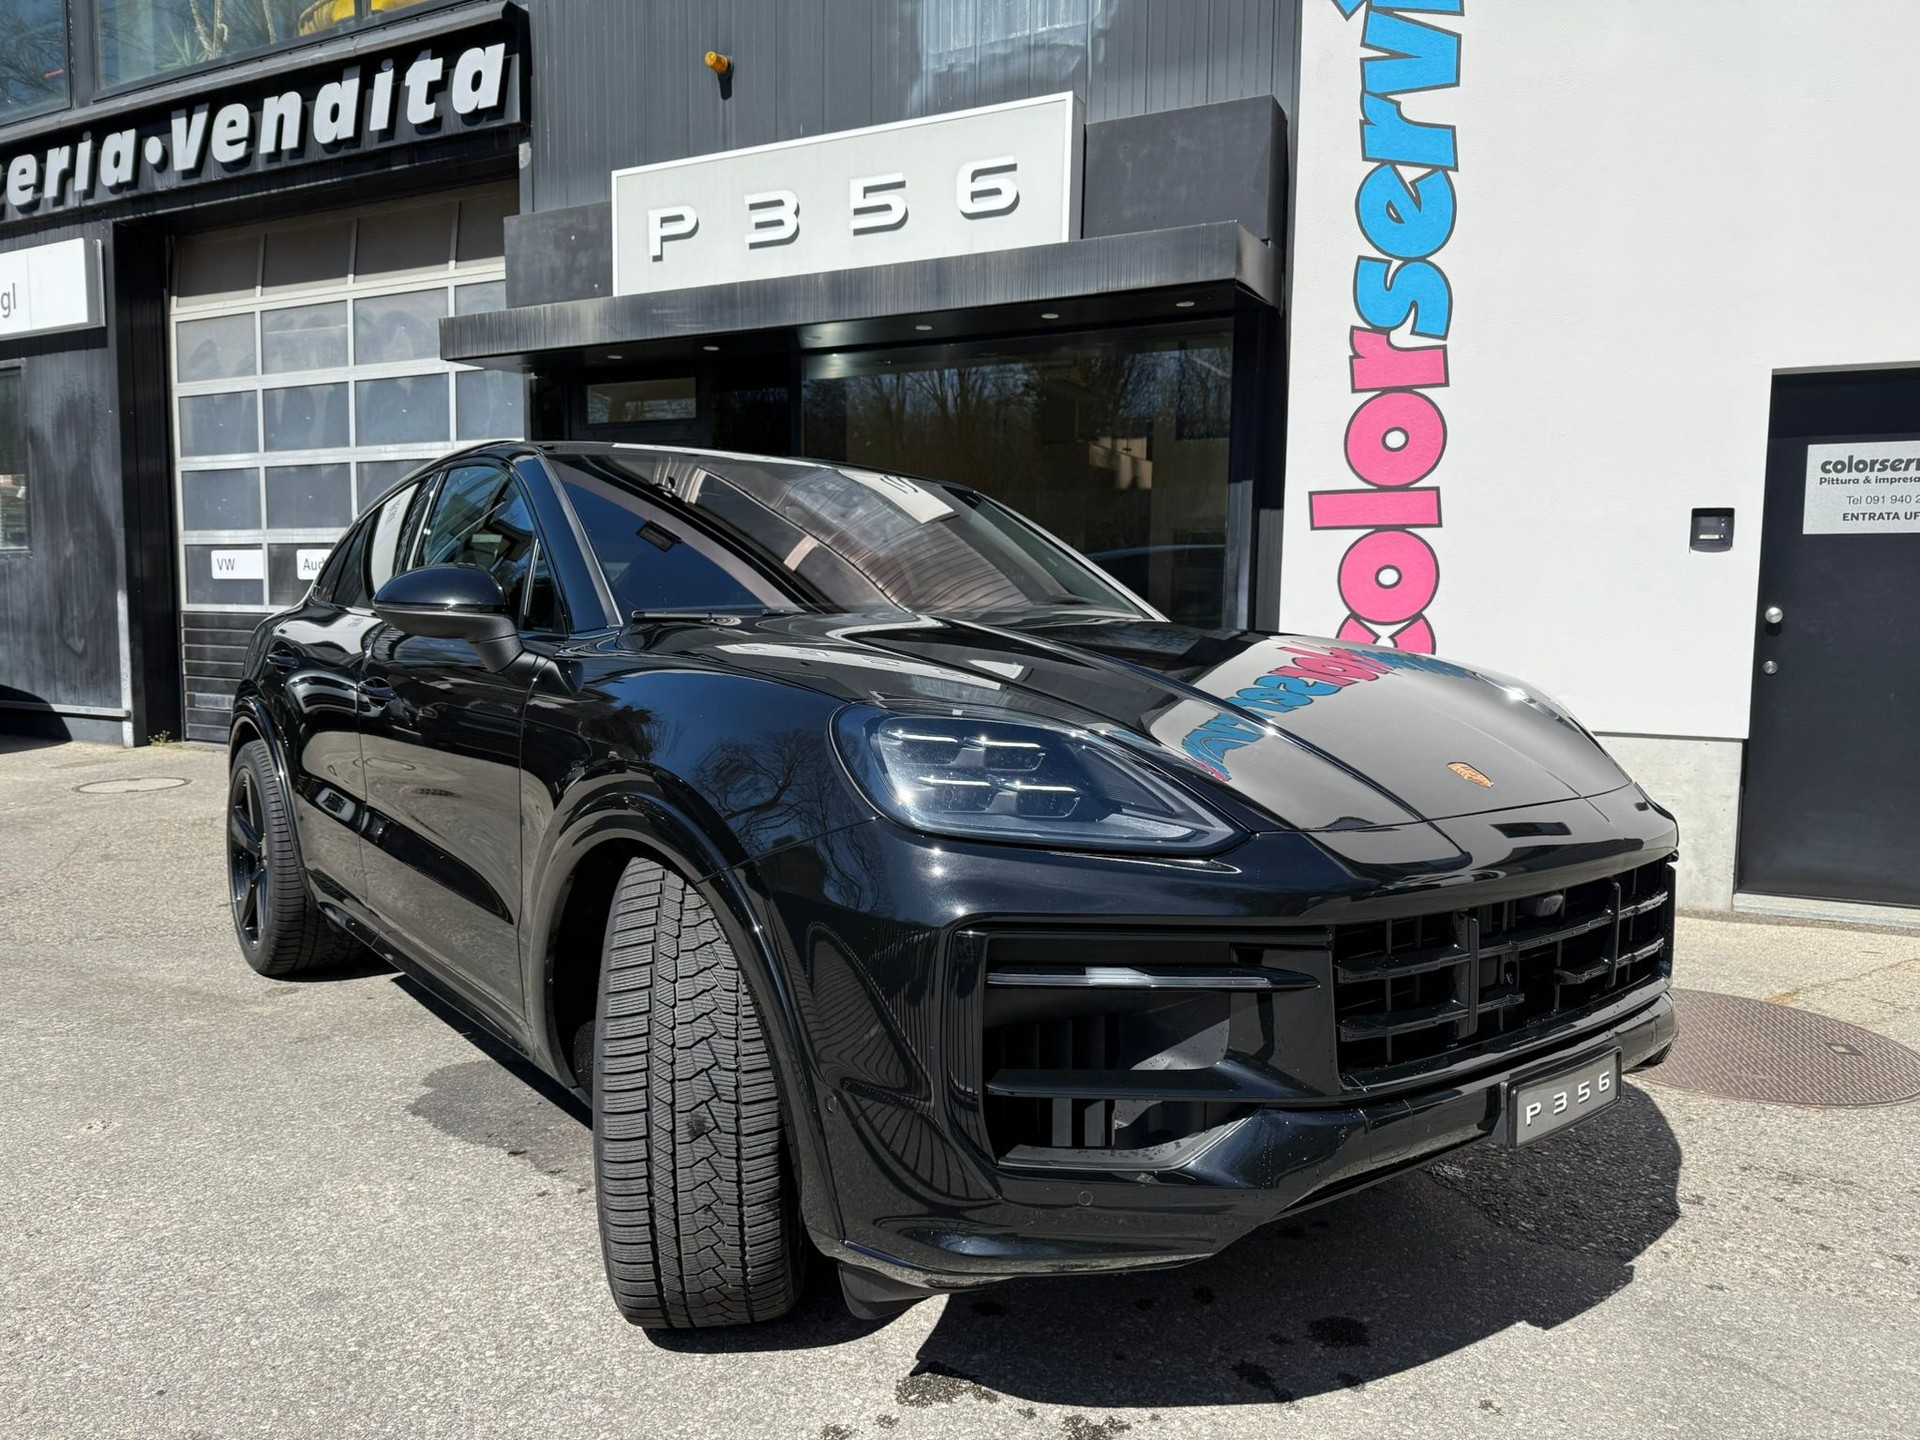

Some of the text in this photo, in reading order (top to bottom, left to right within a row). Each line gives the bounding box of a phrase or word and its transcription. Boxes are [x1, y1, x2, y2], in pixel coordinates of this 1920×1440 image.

[0, 129, 136, 205] eria
[1819, 475, 1920, 485] Pittura & impresa
[1846, 495, 1862, 505] Tel
[1865, 495, 1886, 505] 091
[1890, 494, 1912, 504] 940
[1842, 511, 1900, 521] ENTRATA
[216, 557, 236, 571] VW
